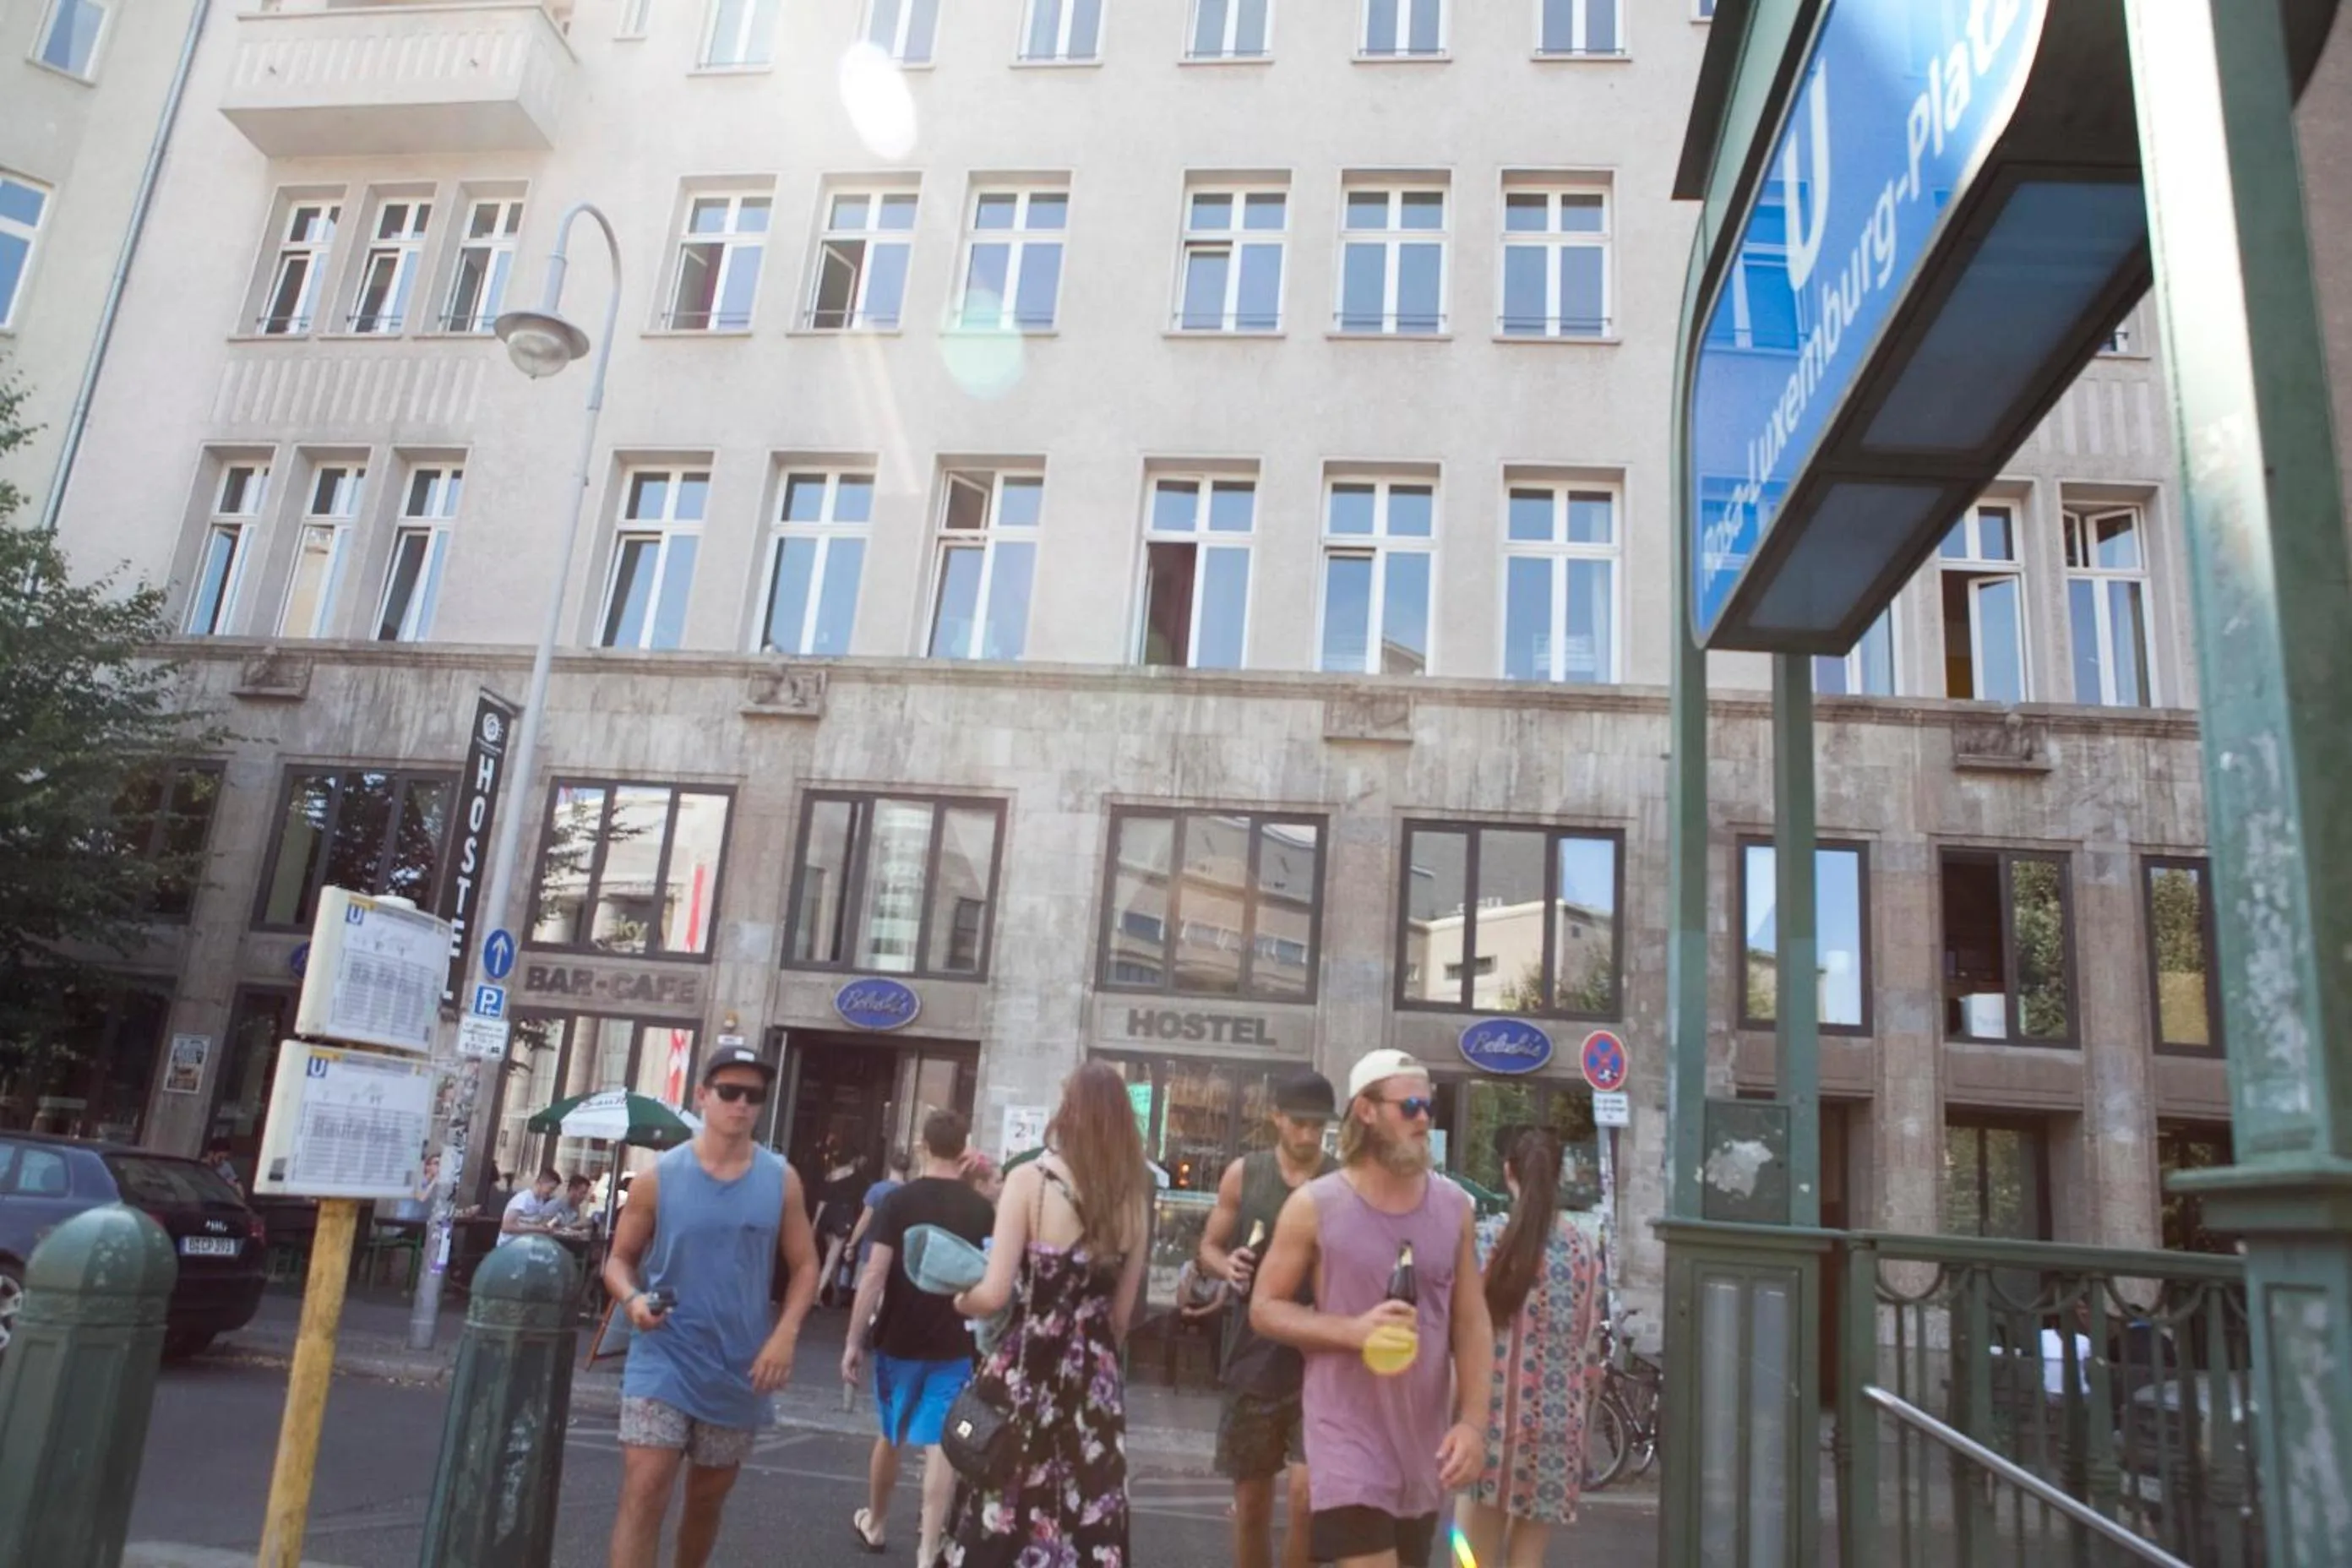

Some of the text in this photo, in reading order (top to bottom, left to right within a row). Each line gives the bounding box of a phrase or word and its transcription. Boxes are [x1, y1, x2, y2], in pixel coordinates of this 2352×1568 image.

[1782, 57, 1831, 291] U
[443, 754, 495, 1000] HOSTE
[349, 905, 363, 923] U
[480, 988, 498, 1014] P
[1126, 1009, 1277, 1046] HOSTEL
[310, 1058, 326, 1076] U
